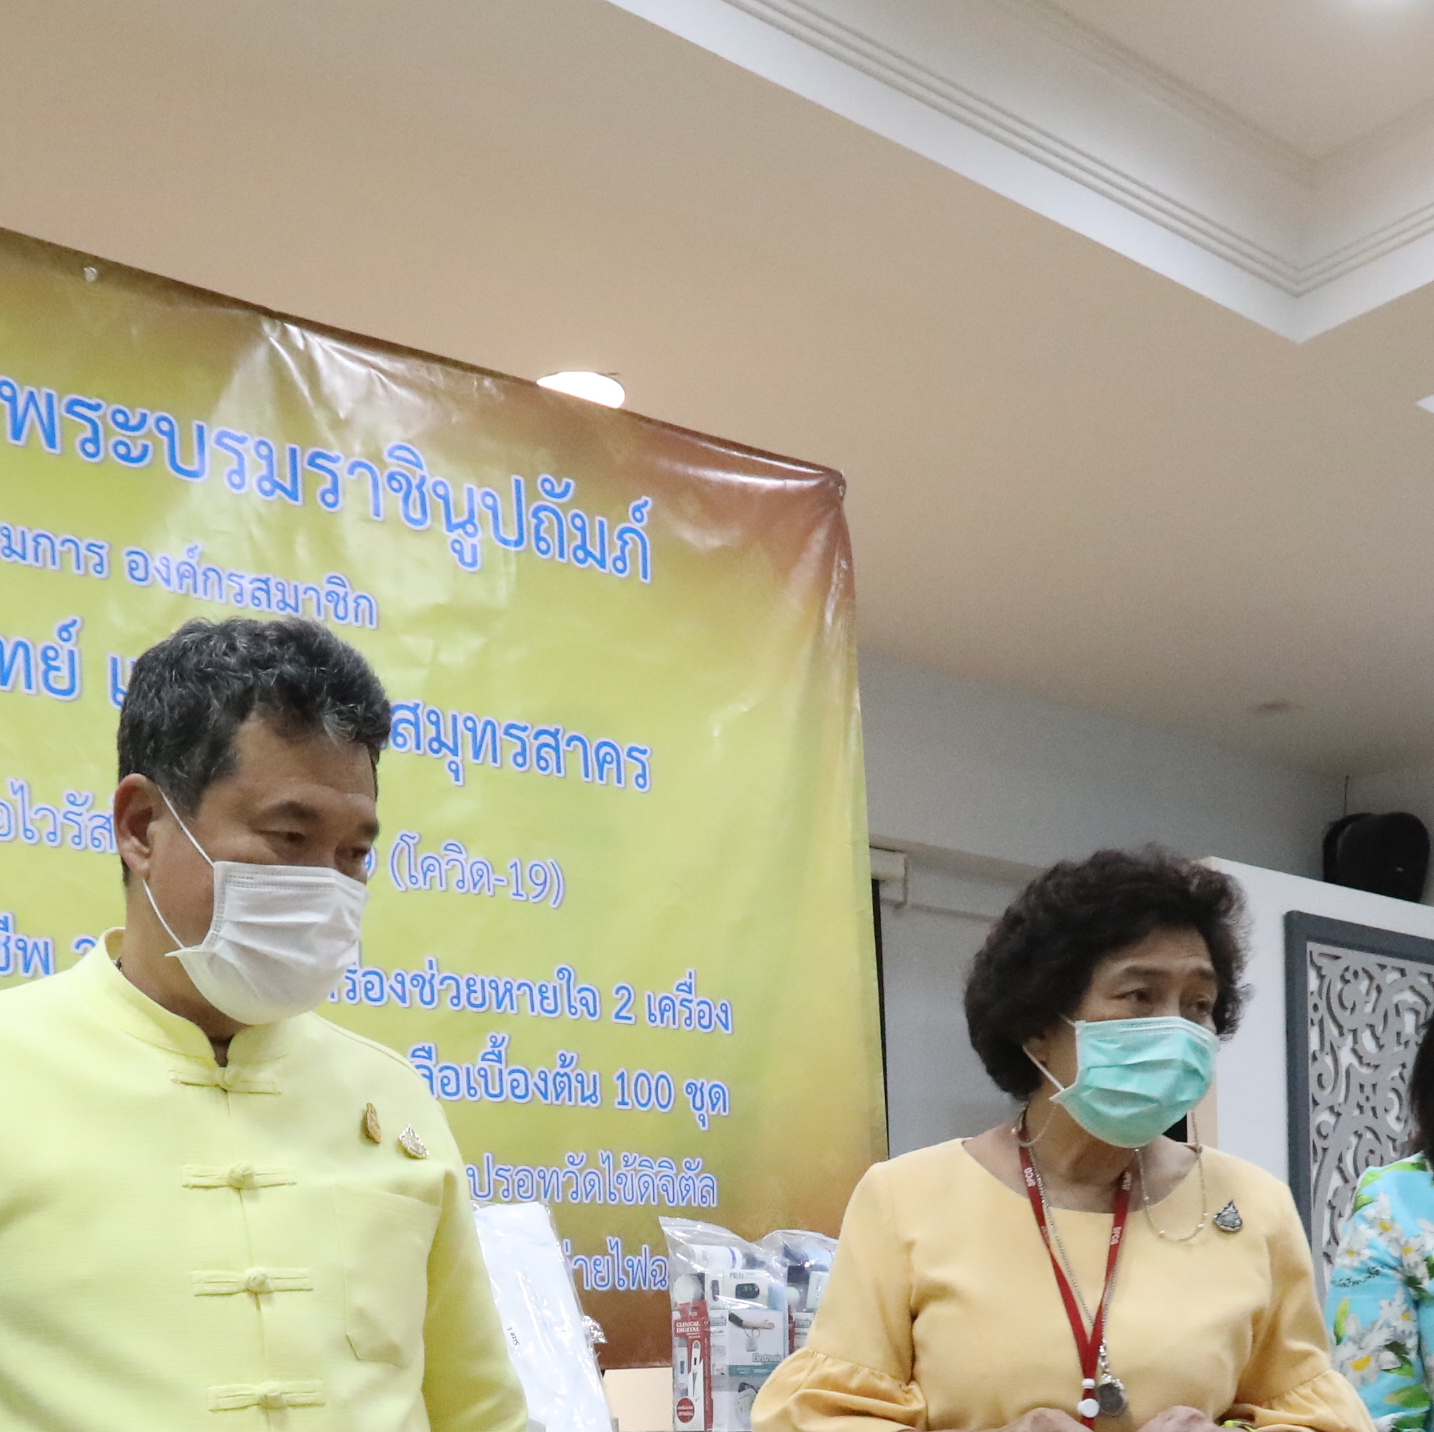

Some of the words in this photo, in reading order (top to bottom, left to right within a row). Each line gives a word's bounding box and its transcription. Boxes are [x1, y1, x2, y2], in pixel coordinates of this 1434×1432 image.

[123, 543, 378, 628] องค์กรสมาชิก
[388, 831, 565, 907] (โควิด-19)
[611, 983, 636, 1024] 2
[645, 970, 733, 1034] เครื่อง
[613, 1069, 675, 1112] 100
[683, 1079, 730, 1130] ชุด
